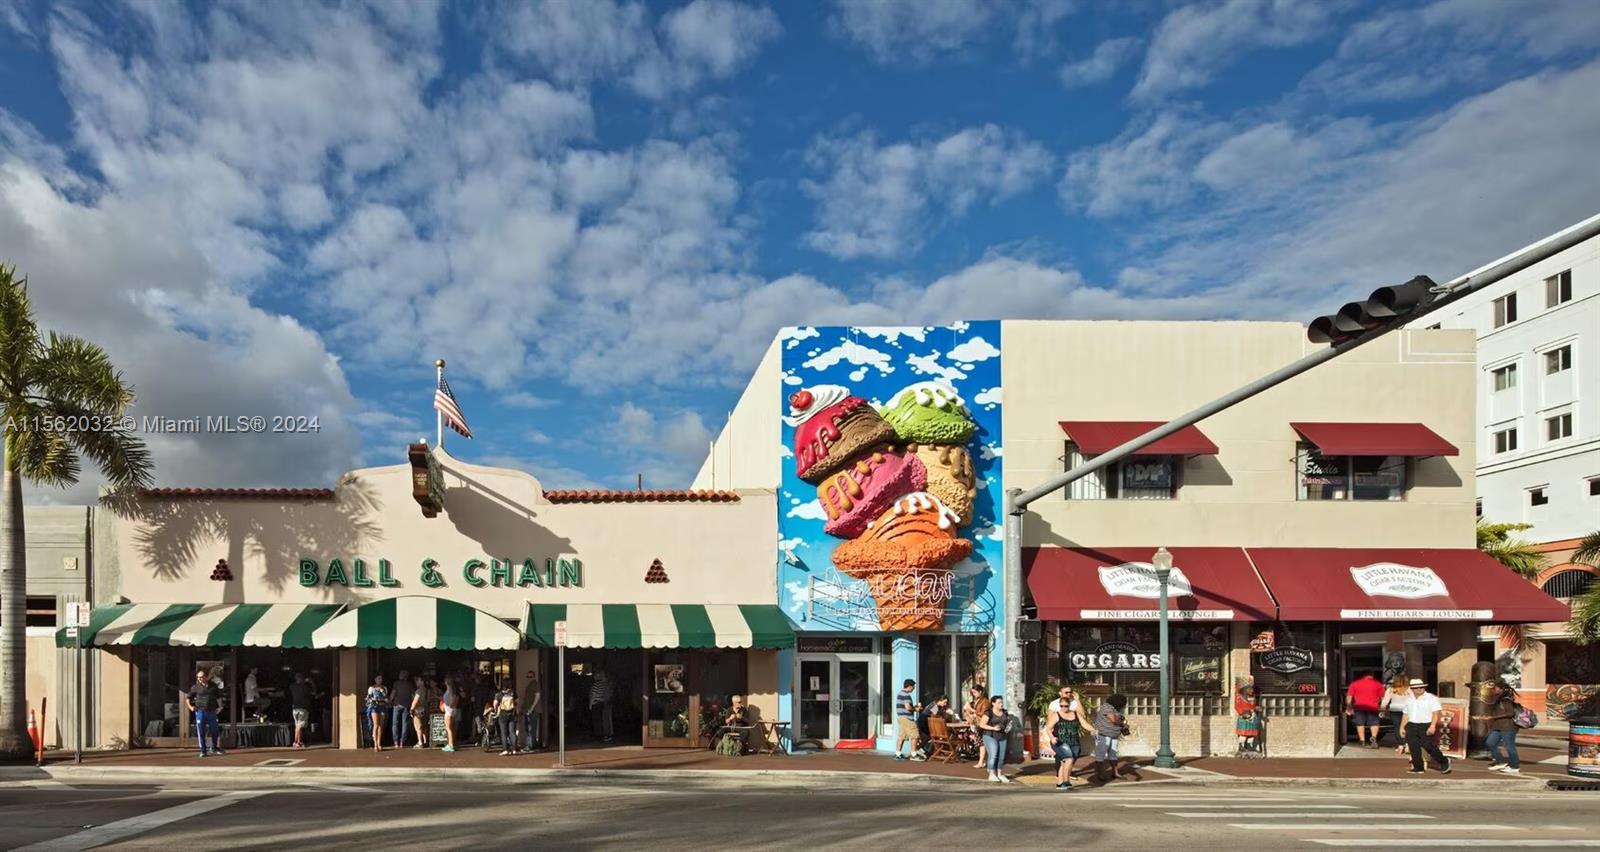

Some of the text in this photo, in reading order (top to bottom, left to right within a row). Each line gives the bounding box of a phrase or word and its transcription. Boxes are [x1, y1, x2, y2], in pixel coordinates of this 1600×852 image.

[1305, 461, 1338, 474] Studio
[299, 558, 584, 589] BALL & CHAIN
[1106, 566, 1133, 580] LITTLE
[1361, 567, 1433, 581] LITTLE HAVANA
[1369, 576, 1432, 588] CIGAR FACTORY
[1072, 653, 1160, 669] CIGARS
[1264, 650, 1308, 661] LITTLE HAVANA
[1297, 683, 1317, 692] OPEN
